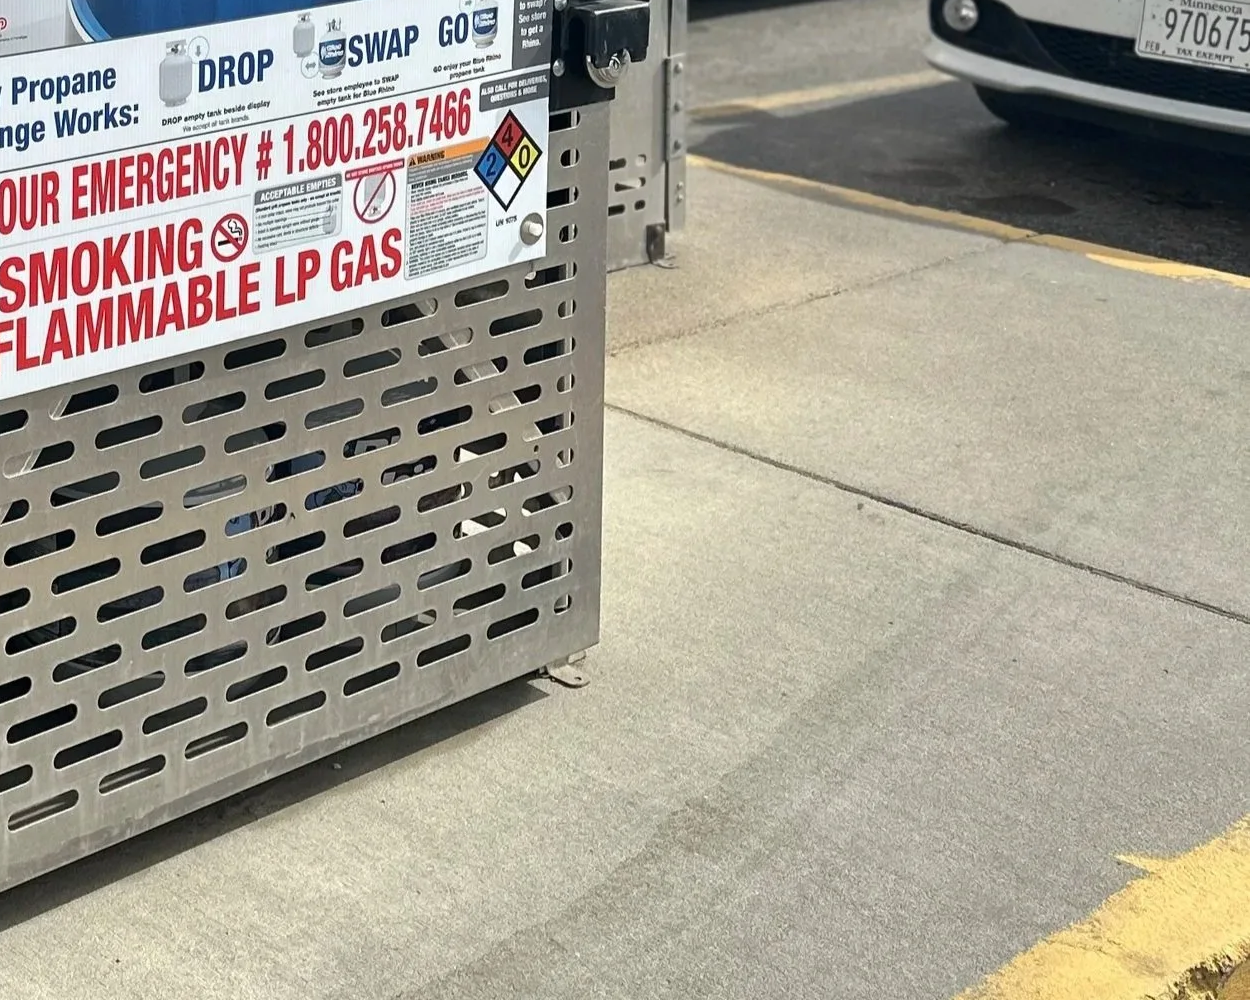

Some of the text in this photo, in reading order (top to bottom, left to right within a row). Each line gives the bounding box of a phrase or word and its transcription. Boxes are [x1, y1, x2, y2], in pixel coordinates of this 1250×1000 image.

[518, 11, 547, 24] See store
[519, 1, 526, 10] to
[438, 12, 469, 48] GO
[521, 27, 527, 36] to
[528, 25, 538, 36] get
[1165, 7, 1250, 53] 970675
[348, 25, 419, 67] SWAP
[522, 38, 541, 49] Rhino.
[1145, 40, 1160, 52] FEB
[1177, 47, 1235, 63] TAX EXEMPT
[198, 48, 274, 93] DROP
[433, 65, 442, 73] GO
[443, 62, 458, 71] enjoy
[459, 59, 471, 69] your
[486, 53, 501, 62] Rhino
[450, 66, 485, 80] propane tank
[12, 67, 117, 105] Propane
[313, 90, 325, 98] See
[326, 86, 342, 95] store
[344, 80, 372, 93] employee
[382, 74, 400, 83] SWAP
[317, 97, 336, 106] empty
[338, 94, 351, 102] tank
[363, 89, 376, 97] Blue
[378, 85, 395, 94] Rhino
[481, 86, 494, 96] ALSO
[495, 84, 507, 93] CALL
[508, 81, 518, 90] FOR
[490, 91, 517, 103] QUESTIONS
[523, 85, 538, 95] MORE
[54, 102, 140, 138] Works:
[161, 100, 271, 126] DROP empty tank beside display
[502, 123, 513, 148] 4
[71, 133, 249, 220] EMERGENCY
[256, 129, 273, 181] #
[283, 87, 472, 175] 1.800.258.7466
[416, 150, 445, 164] WARNING
[486, 152, 497, 177] 2
[519, 144, 531, 169] 0
[260, 184, 305, 202] ACCEPTABLE
[306, 177, 337, 192] EMPTIES
[274, 249, 321, 307] LP
[330, 227, 402, 292] GAS
